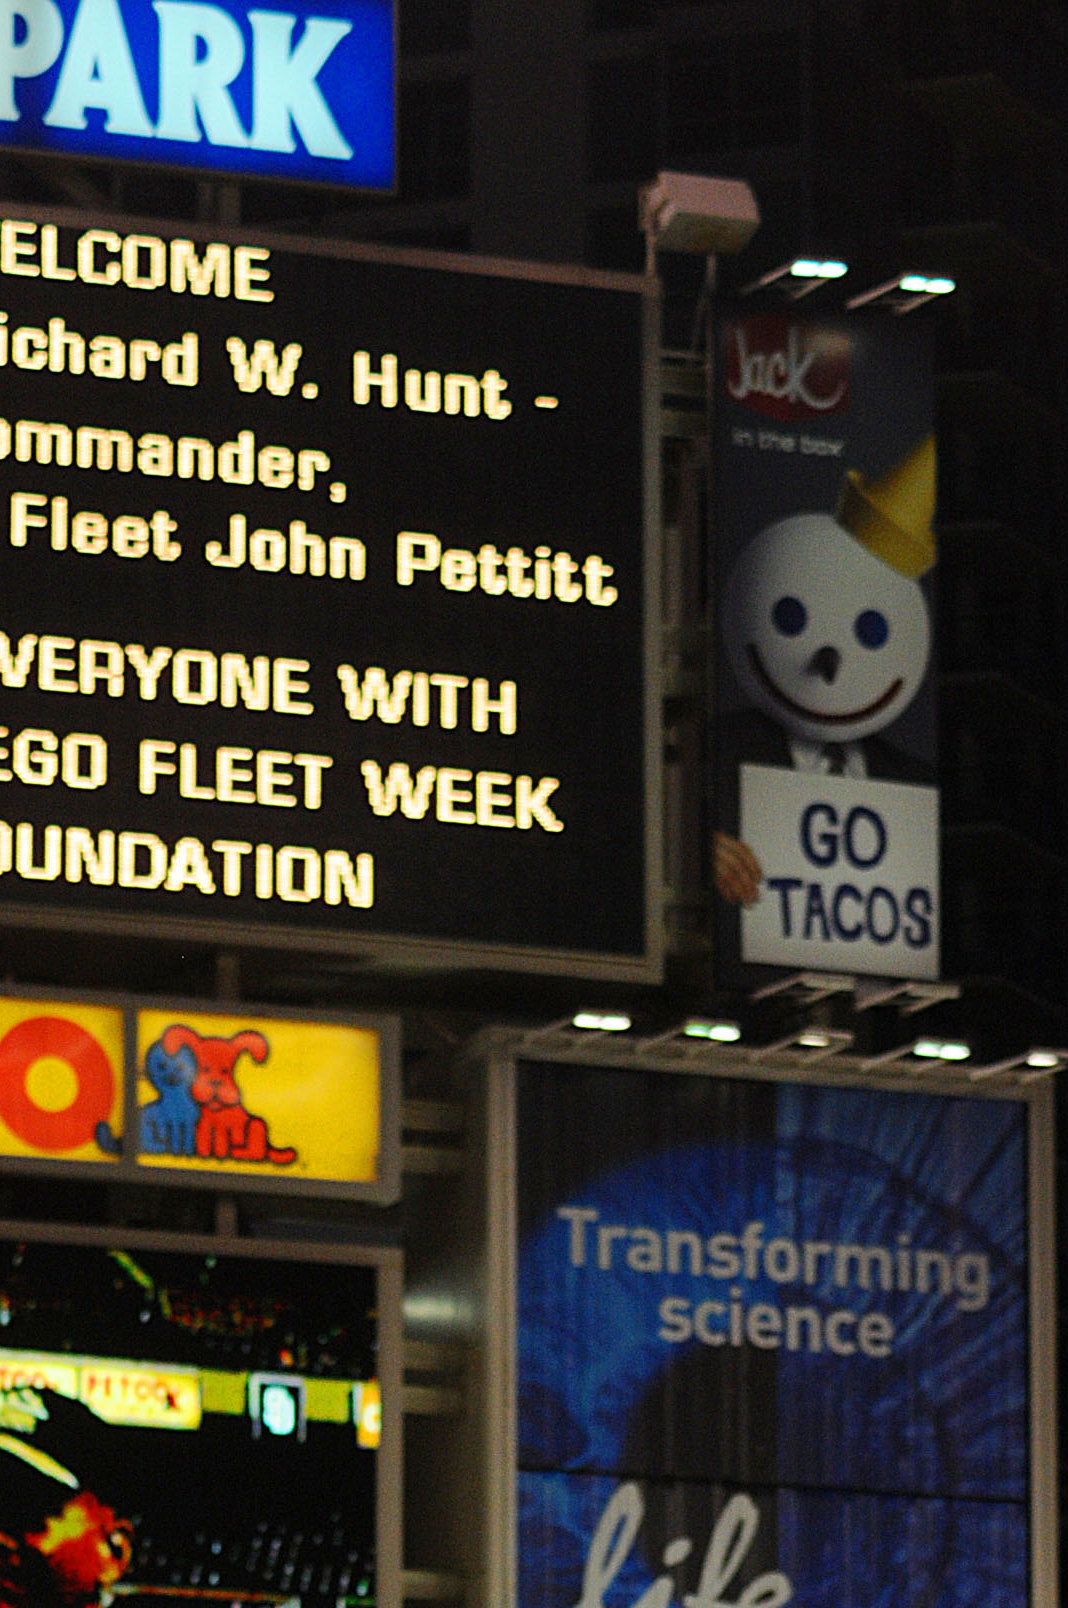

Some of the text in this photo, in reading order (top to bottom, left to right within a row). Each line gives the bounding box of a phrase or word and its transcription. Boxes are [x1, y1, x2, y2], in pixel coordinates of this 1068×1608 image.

[228, 338, 318, 399] W.
[354, 351, 512, 420] Hunt
[728, 326, 847, 410] Jack
[11, 493, 181, 562] Fleet
[206, 514, 365, 580] John
[397, 532, 617, 606] Pettitt
[337, 664, 517, 734] WITH
[139, 740, 332, 809] FLEET
[361, 759, 563, 832] WEEK
[800, 803, 886, 869] GO
[766, 876, 930, 949] TACOS
[557, 1205, 990, 1312] Transforming
[658, 1291, 895, 1358] science
